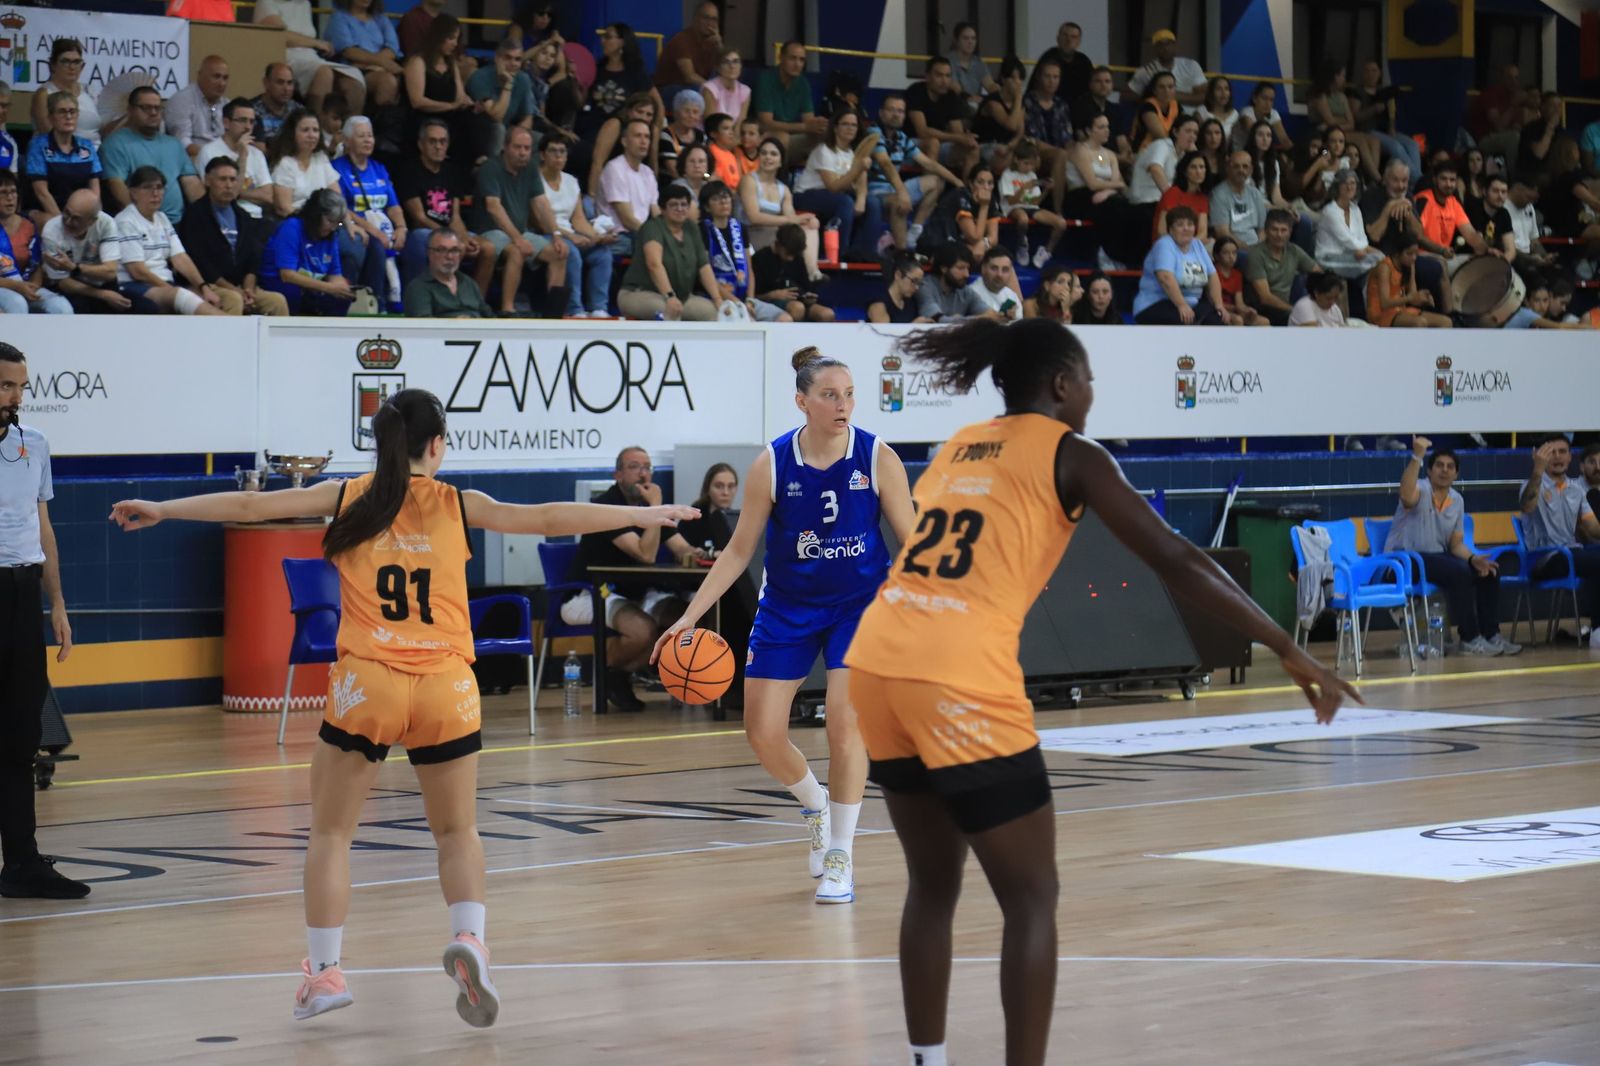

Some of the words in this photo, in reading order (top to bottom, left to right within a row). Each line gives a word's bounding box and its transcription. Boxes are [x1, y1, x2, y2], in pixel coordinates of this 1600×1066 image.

[445, 340, 694, 414] ZAMORA
[1199, 371, 1263, 394] ZAMORA
[1455, 370, 1512, 392] ZAMORA
[446, 428, 602, 450] AYUNTAMIENTO
[820, 490, 839, 524] 3
[901, 507, 985, 579] 23
[376, 564, 434, 625] 91
